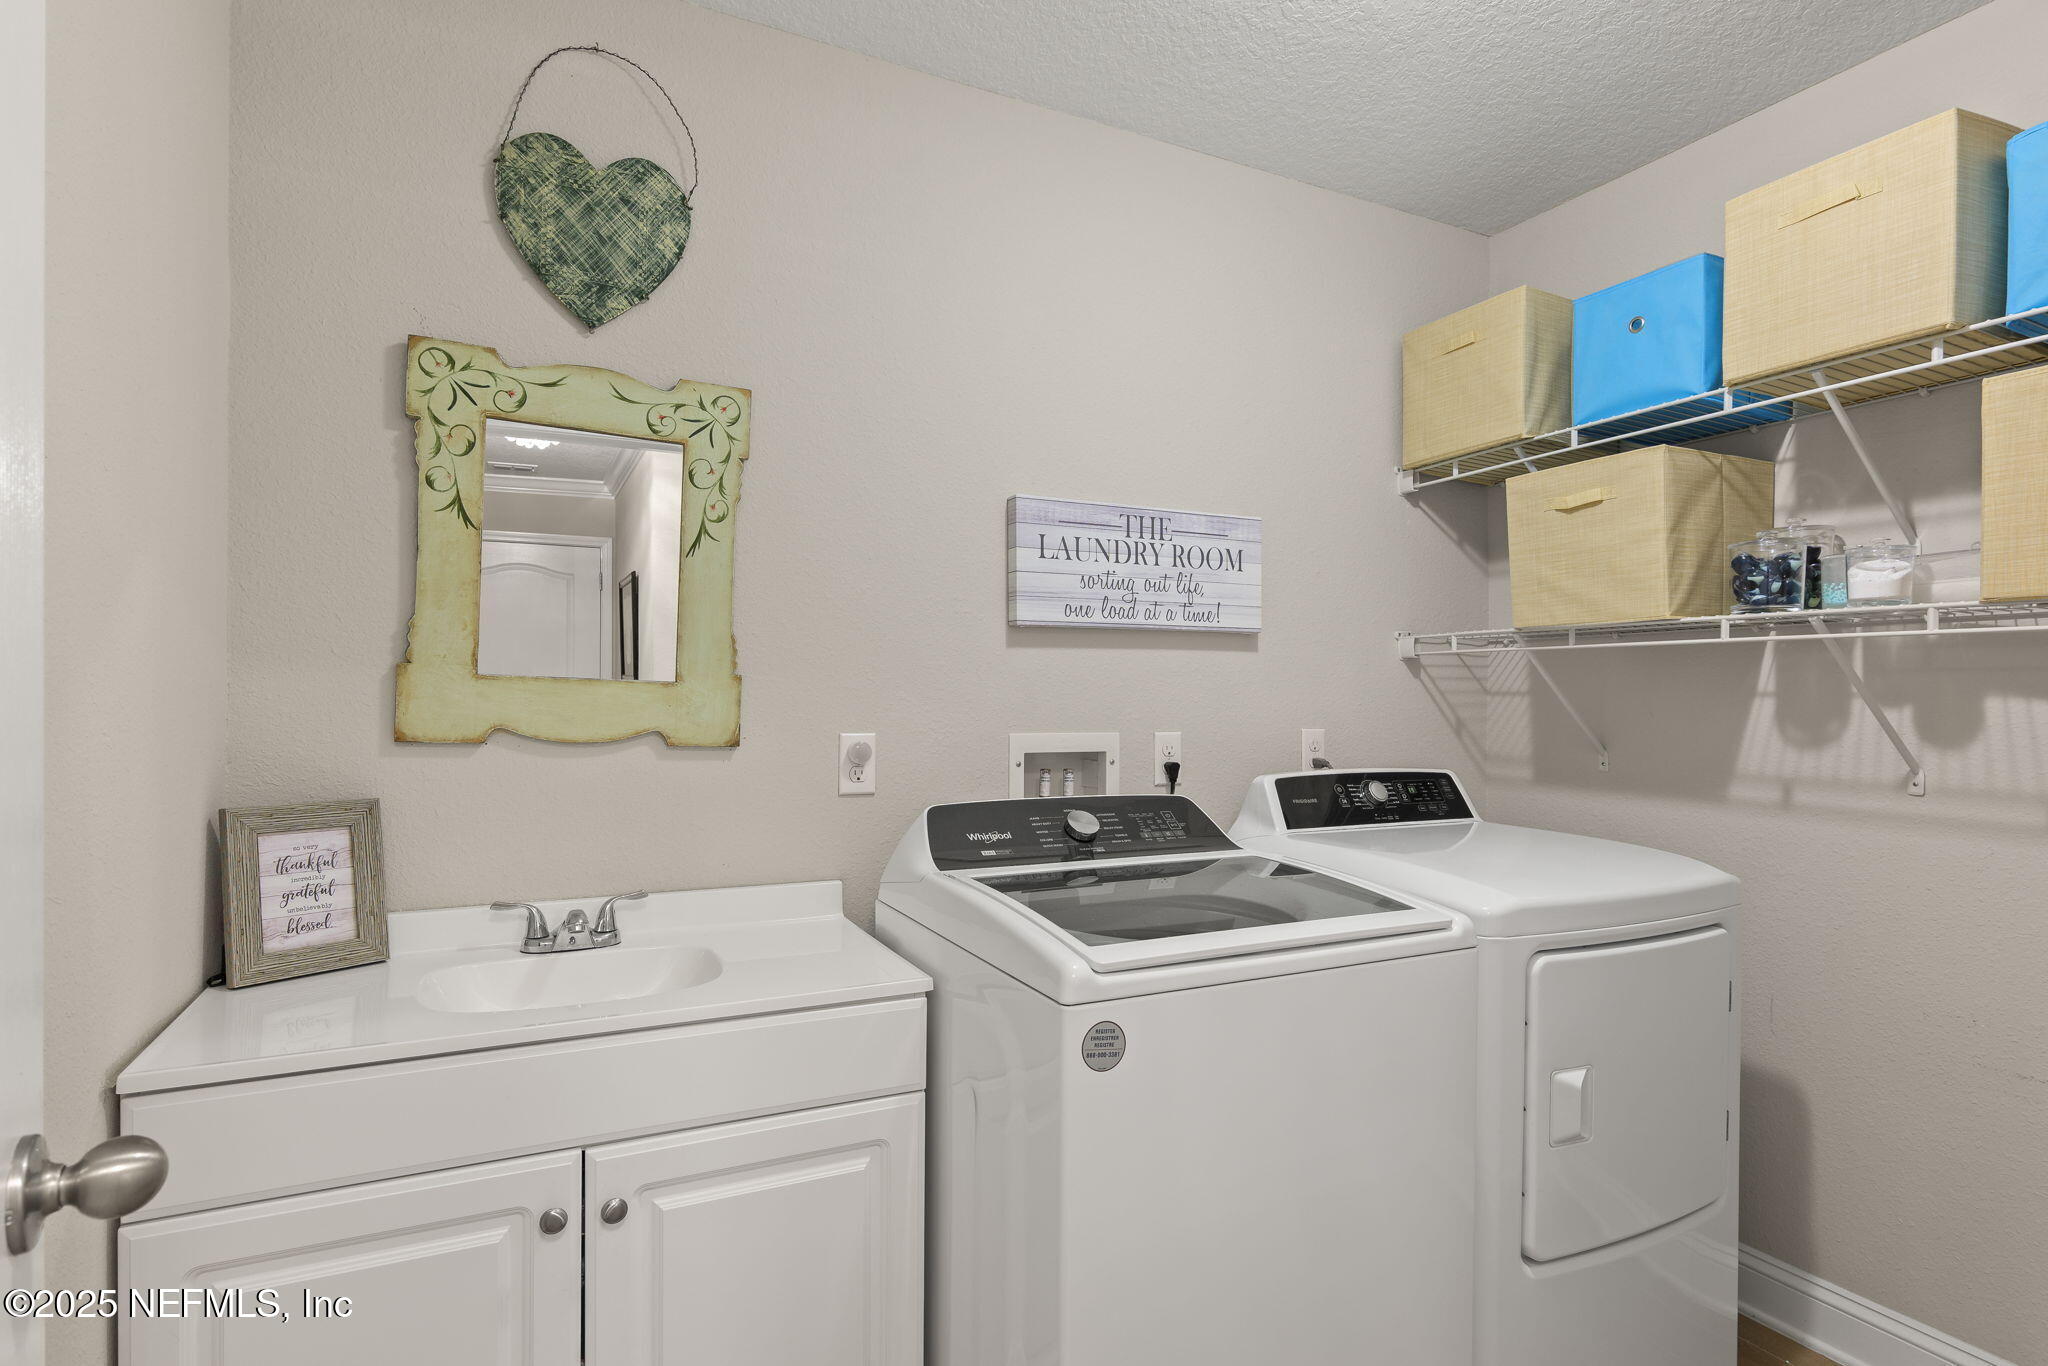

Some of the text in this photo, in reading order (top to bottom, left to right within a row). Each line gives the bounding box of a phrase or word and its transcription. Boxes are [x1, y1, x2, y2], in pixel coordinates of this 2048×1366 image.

[1119, 513, 1173, 542] THE
[1038, 533, 1244, 572] LAUNDRY ROOM
[1079, 570, 1205, 604] sorting out life,
[1064, 596, 1221, 624] one load at a time!
[302, 843, 319, 852] very
[966, 831, 1013, 844] Whirlpool
[275, 850, 340, 876] thankful
[290, 874, 326, 883] incredibly
[280, 879, 336, 909] grateful
[287, 903, 333, 914] unbelievably
